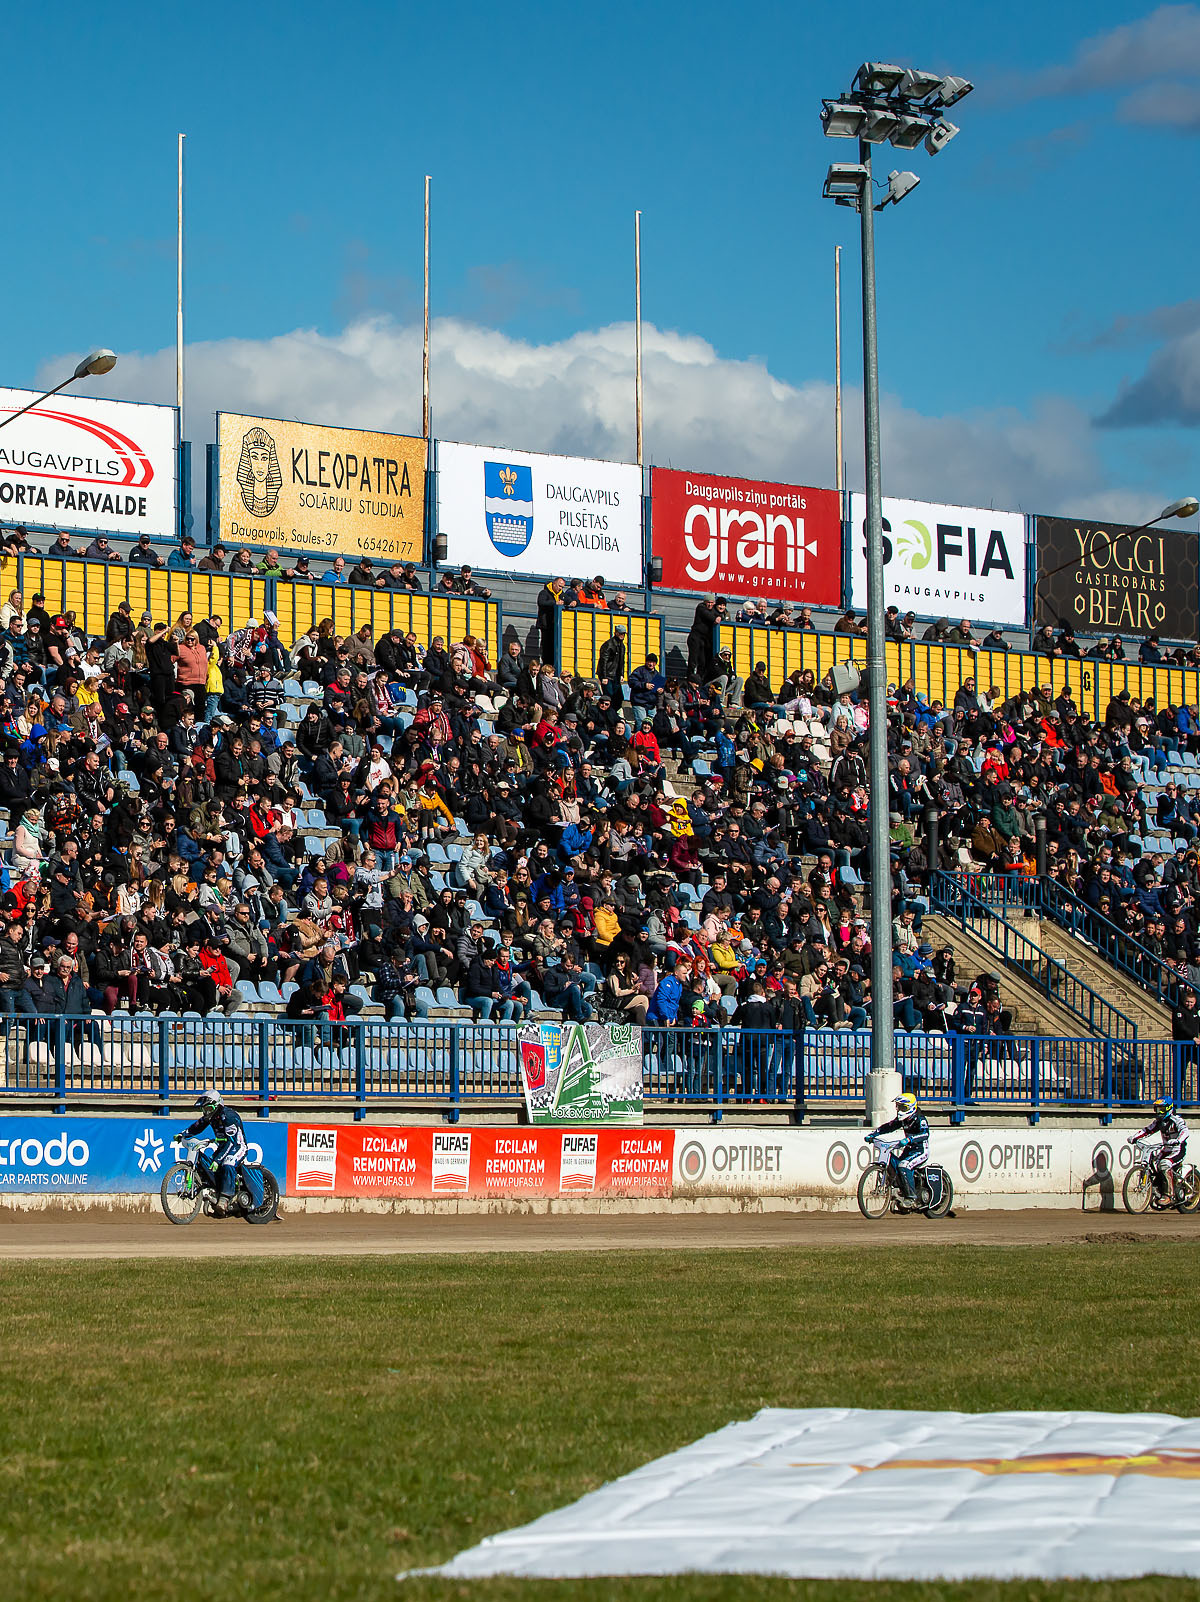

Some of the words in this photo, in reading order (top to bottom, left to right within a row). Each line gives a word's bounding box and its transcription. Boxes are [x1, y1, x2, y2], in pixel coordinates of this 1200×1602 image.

[292, 447, 412, 498] KLEOPATRA
[55, 484, 147, 517] PĀRVALDE
[546, 483, 620, 507] DAUGAVPILS
[685, 480, 743, 504] Daugavpils
[745, 490, 767, 508] ziņu
[769, 492, 806, 509] portāls
[299, 492, 352, 513] SOLĀRIJU
[359, 499, 404, 519] STUDIJA
[559, 508, 608, 530] PILSĒTAS
[231, 522, 287, 544] Daugavpils,
[291, 529, 339, 547] Saules-37
[363, 537, 413, 555] 65426177
[548, 529, 620, 552] PAŠVALDĪBA
[684, 503, 805, 582] grani
[1074, 528, 1165, 576] YOGGI
[719, 571, 806, 590] www.grani.lv
[1075, 571, 1166, 592] GASTROBĀRS
[894, 584, 986, 602] DAUGAVPILS
[1089, 587, 1157, 630] BEAR
[1083, 671, 1092, 692] G
[551, 1107, 606, 1119] LOKOMOTIV
[299, 1132, 335, 1149] PUFAS
[362, 1137, 408, 1153] IZCILAM
[434, 1136, 469, 1152] PUFAS
[495, 1139, 537, 1154] IZCILAM
[563, 1137, 596, 1152] PUFAS
[621, 1139, 662, 1154] IZCILAM
[353, 1157, 416, 1173] REMONTAM
[485, 1159, 545, 1174] REMONTAM
[611, 1159, 669, 1174] REMONTAM
[712, 1145, 783, 1172] OPTIBET
[989, 1144, 1053, 1170] OPTIBET
[17, 1173, 49, 1185] PARTS
[51, 1173, 88, 1185] ONLINE
[352, 1175, 415, 1187] WWW.PUFAS.LV
[485, 1175, 545, 1188] WWW.PUFAS.LV
[611, 1176, 669, 1187] WWW.PUFAS.LV
